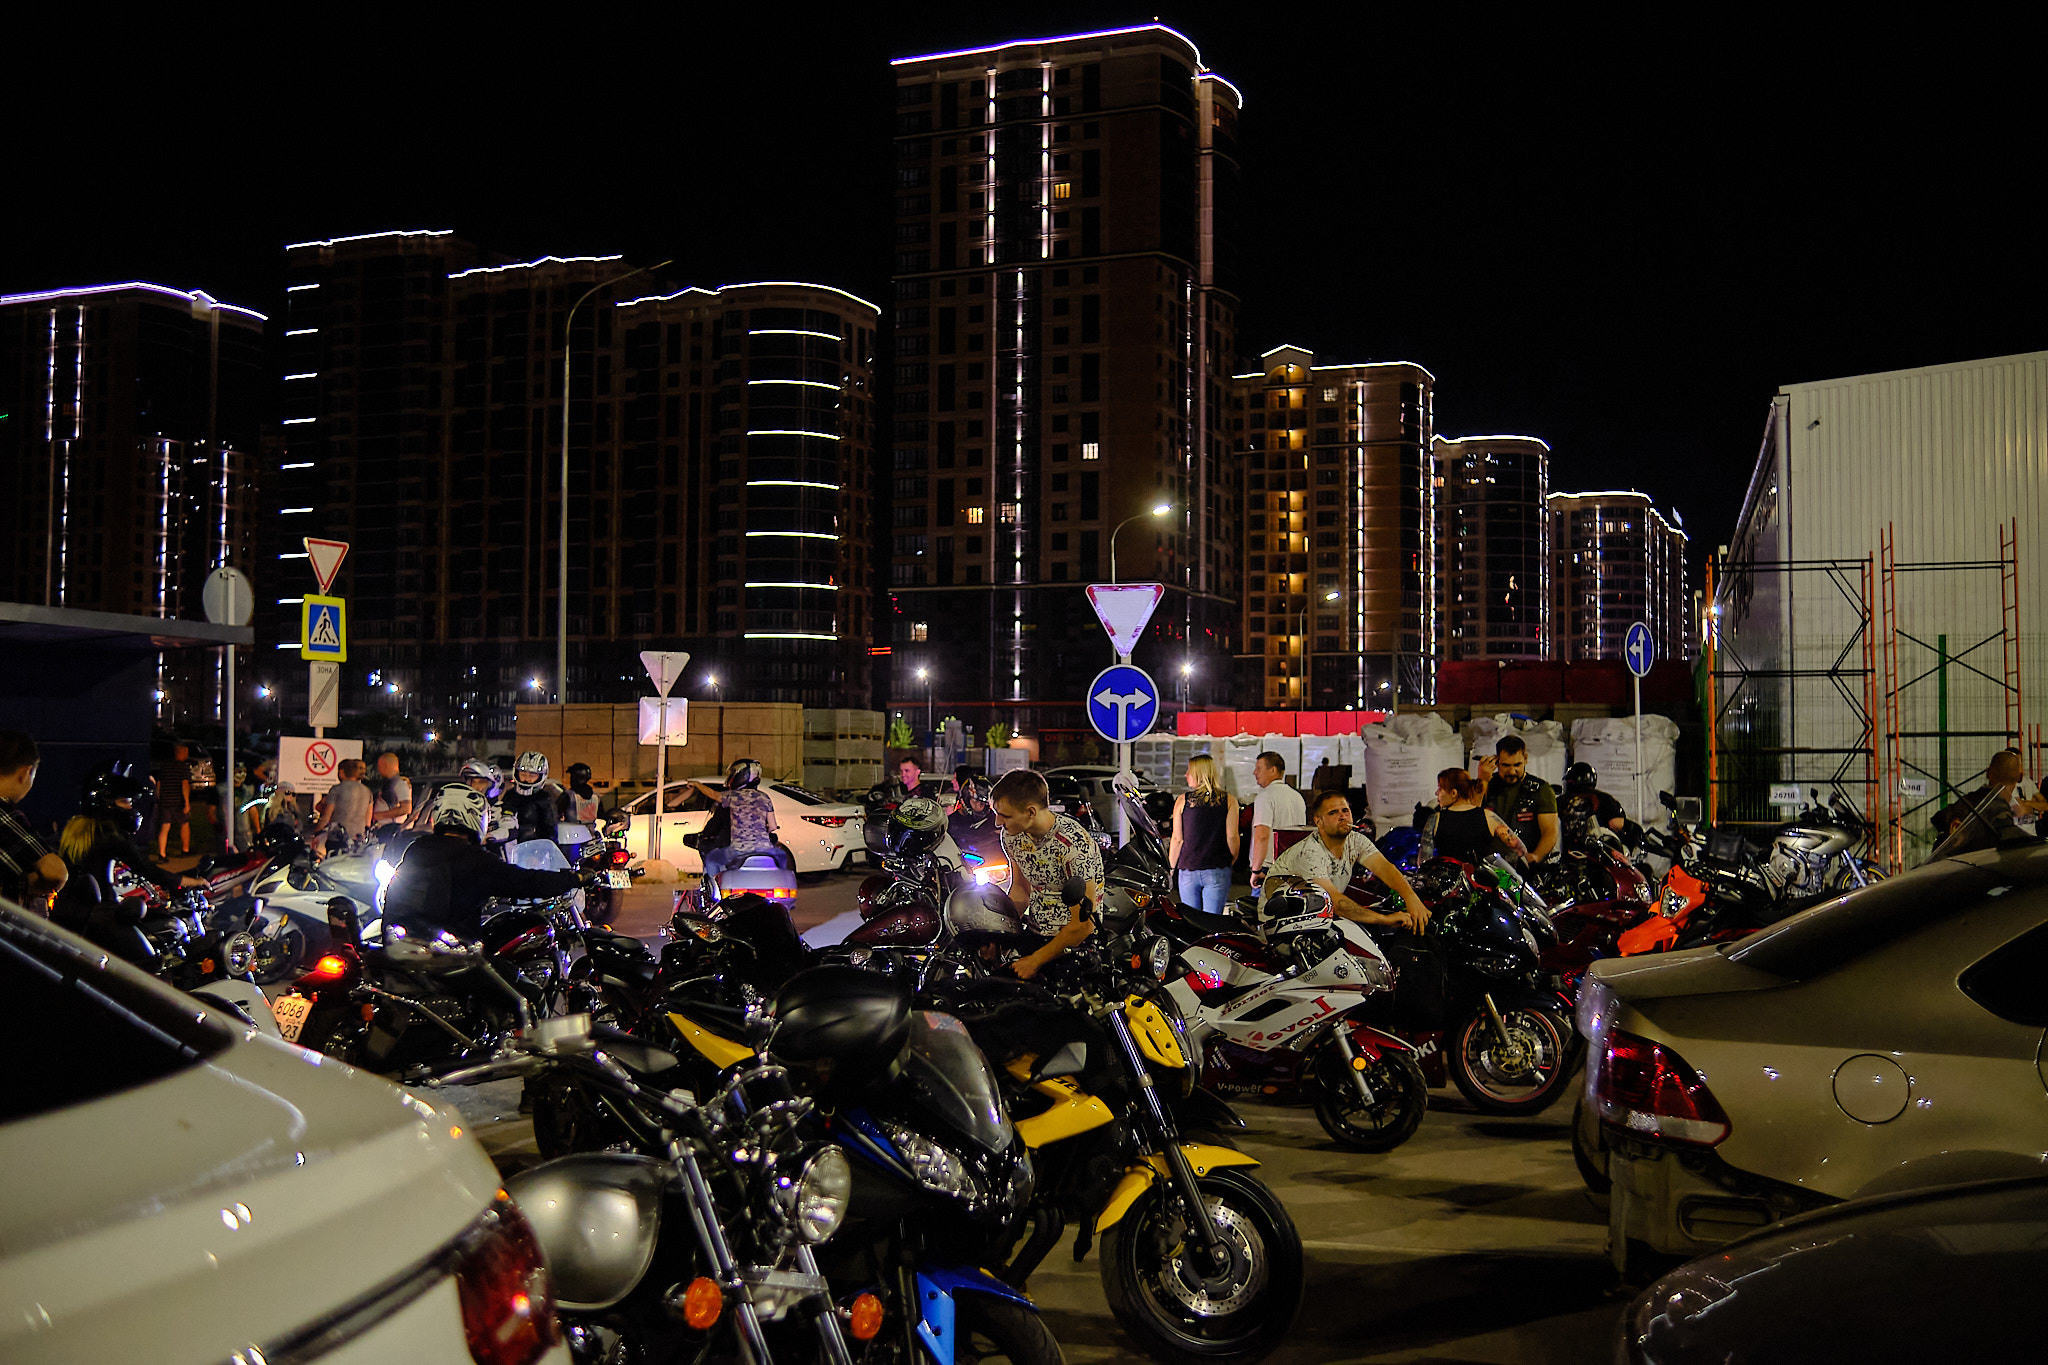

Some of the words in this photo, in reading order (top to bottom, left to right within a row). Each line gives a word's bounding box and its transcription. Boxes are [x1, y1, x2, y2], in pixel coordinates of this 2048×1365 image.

[317, 665, 332, 673] ЗОНА
[1213, 943, 1241, 959] LEIKE
[276, 1001, 305, 1018] 8068
